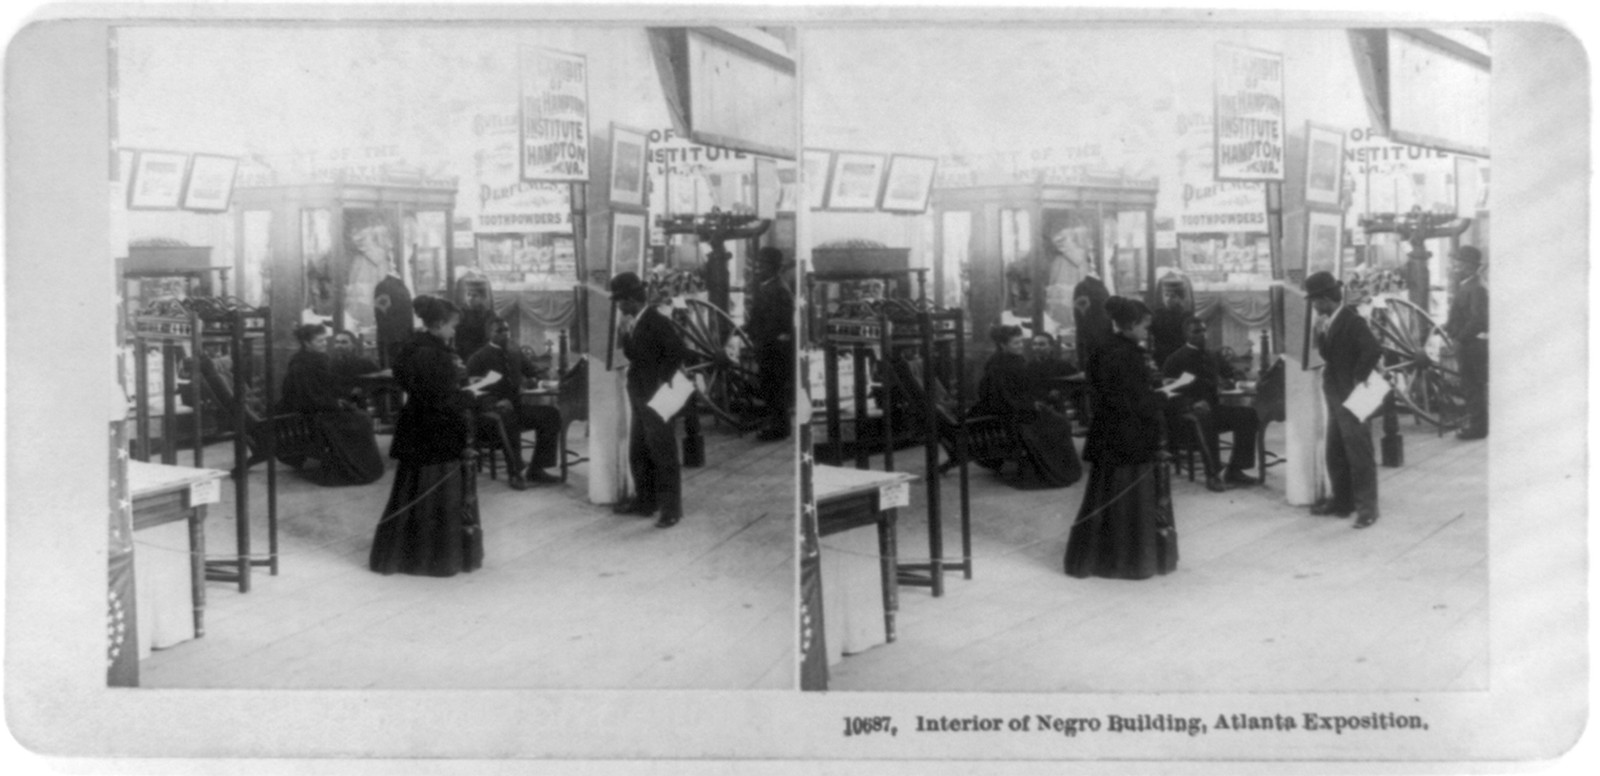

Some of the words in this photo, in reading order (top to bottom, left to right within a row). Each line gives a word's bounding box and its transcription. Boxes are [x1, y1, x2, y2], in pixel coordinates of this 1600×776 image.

[526, 117, 584, 141] INSTITUTE
[649, 129, 675, 143] OF
[1220, 116, 1279, 140] INSTITUTE
[1350, 128, 1377, 142] OF
[527, 142, 587, 166] HAMPTON
[1221, 141, 1282, 165] HAMPTON
[479, 213, 563, 226] TOOTHPOWDERS
[1181, 212, 1266, 226] TOOTHPOWDERS
